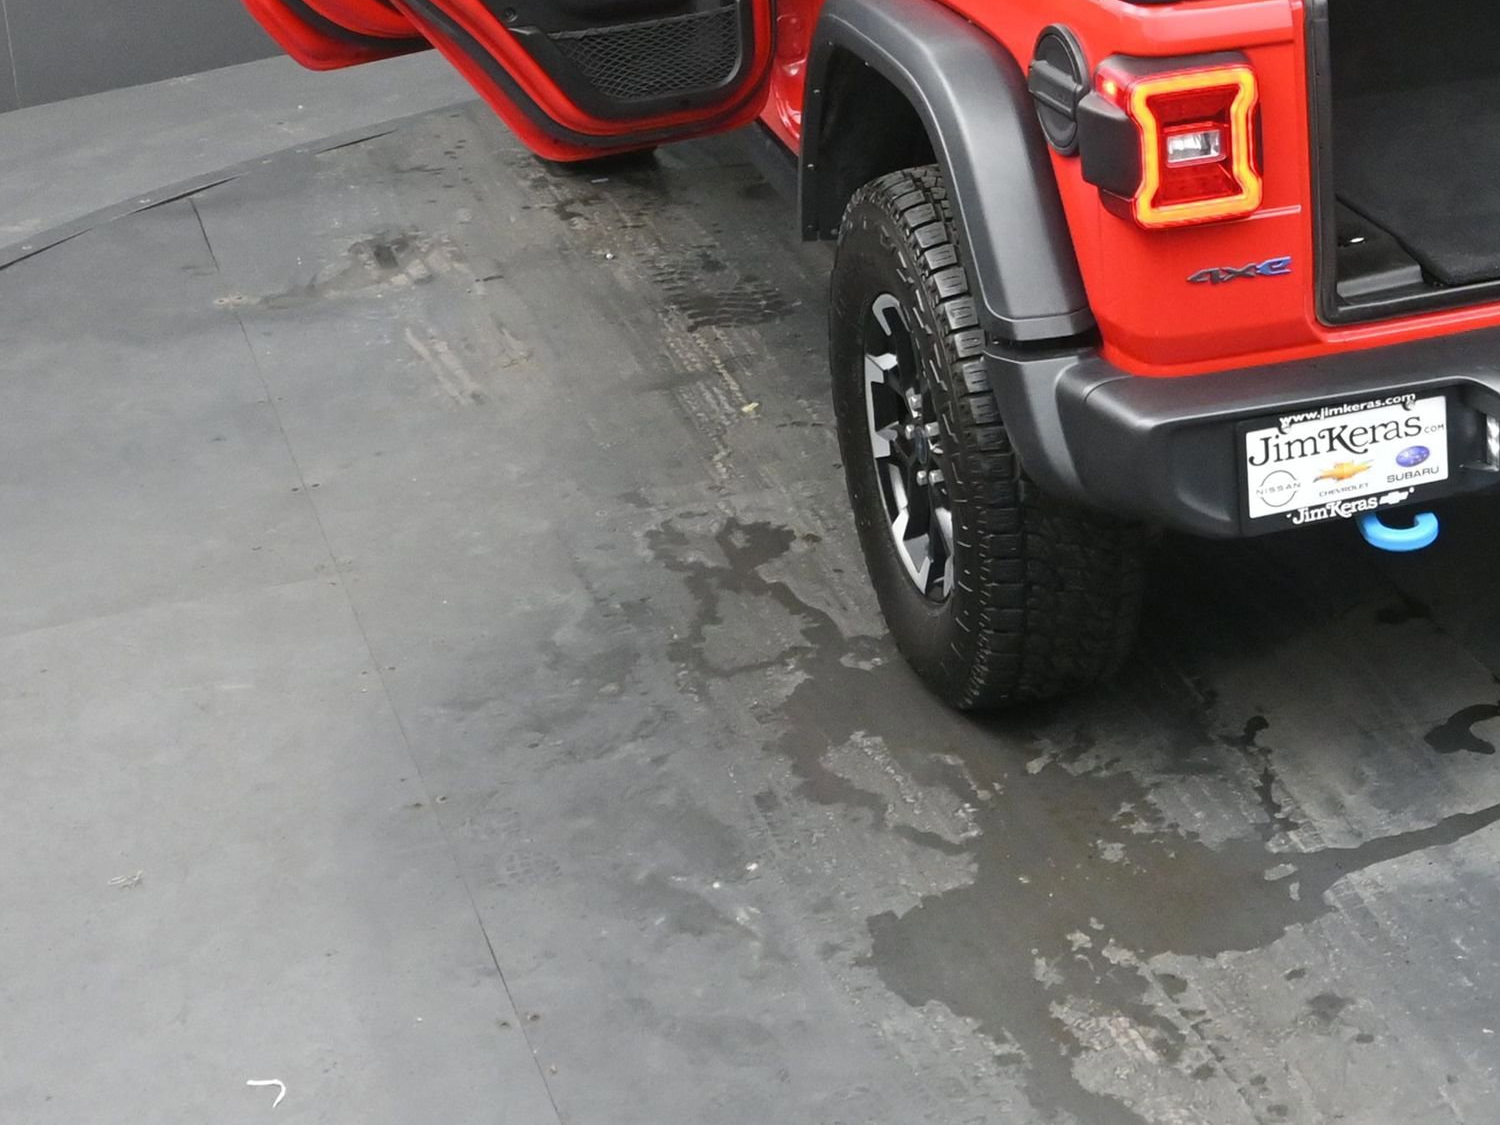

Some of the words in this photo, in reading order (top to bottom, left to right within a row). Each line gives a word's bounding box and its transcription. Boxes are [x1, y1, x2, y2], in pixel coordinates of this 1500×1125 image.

[1386, 466, 1440, 483] SUBARU
[1255, 482, 1301, 496] NISSAN
[1319, 482, 1369, 498] CHEVROLET
